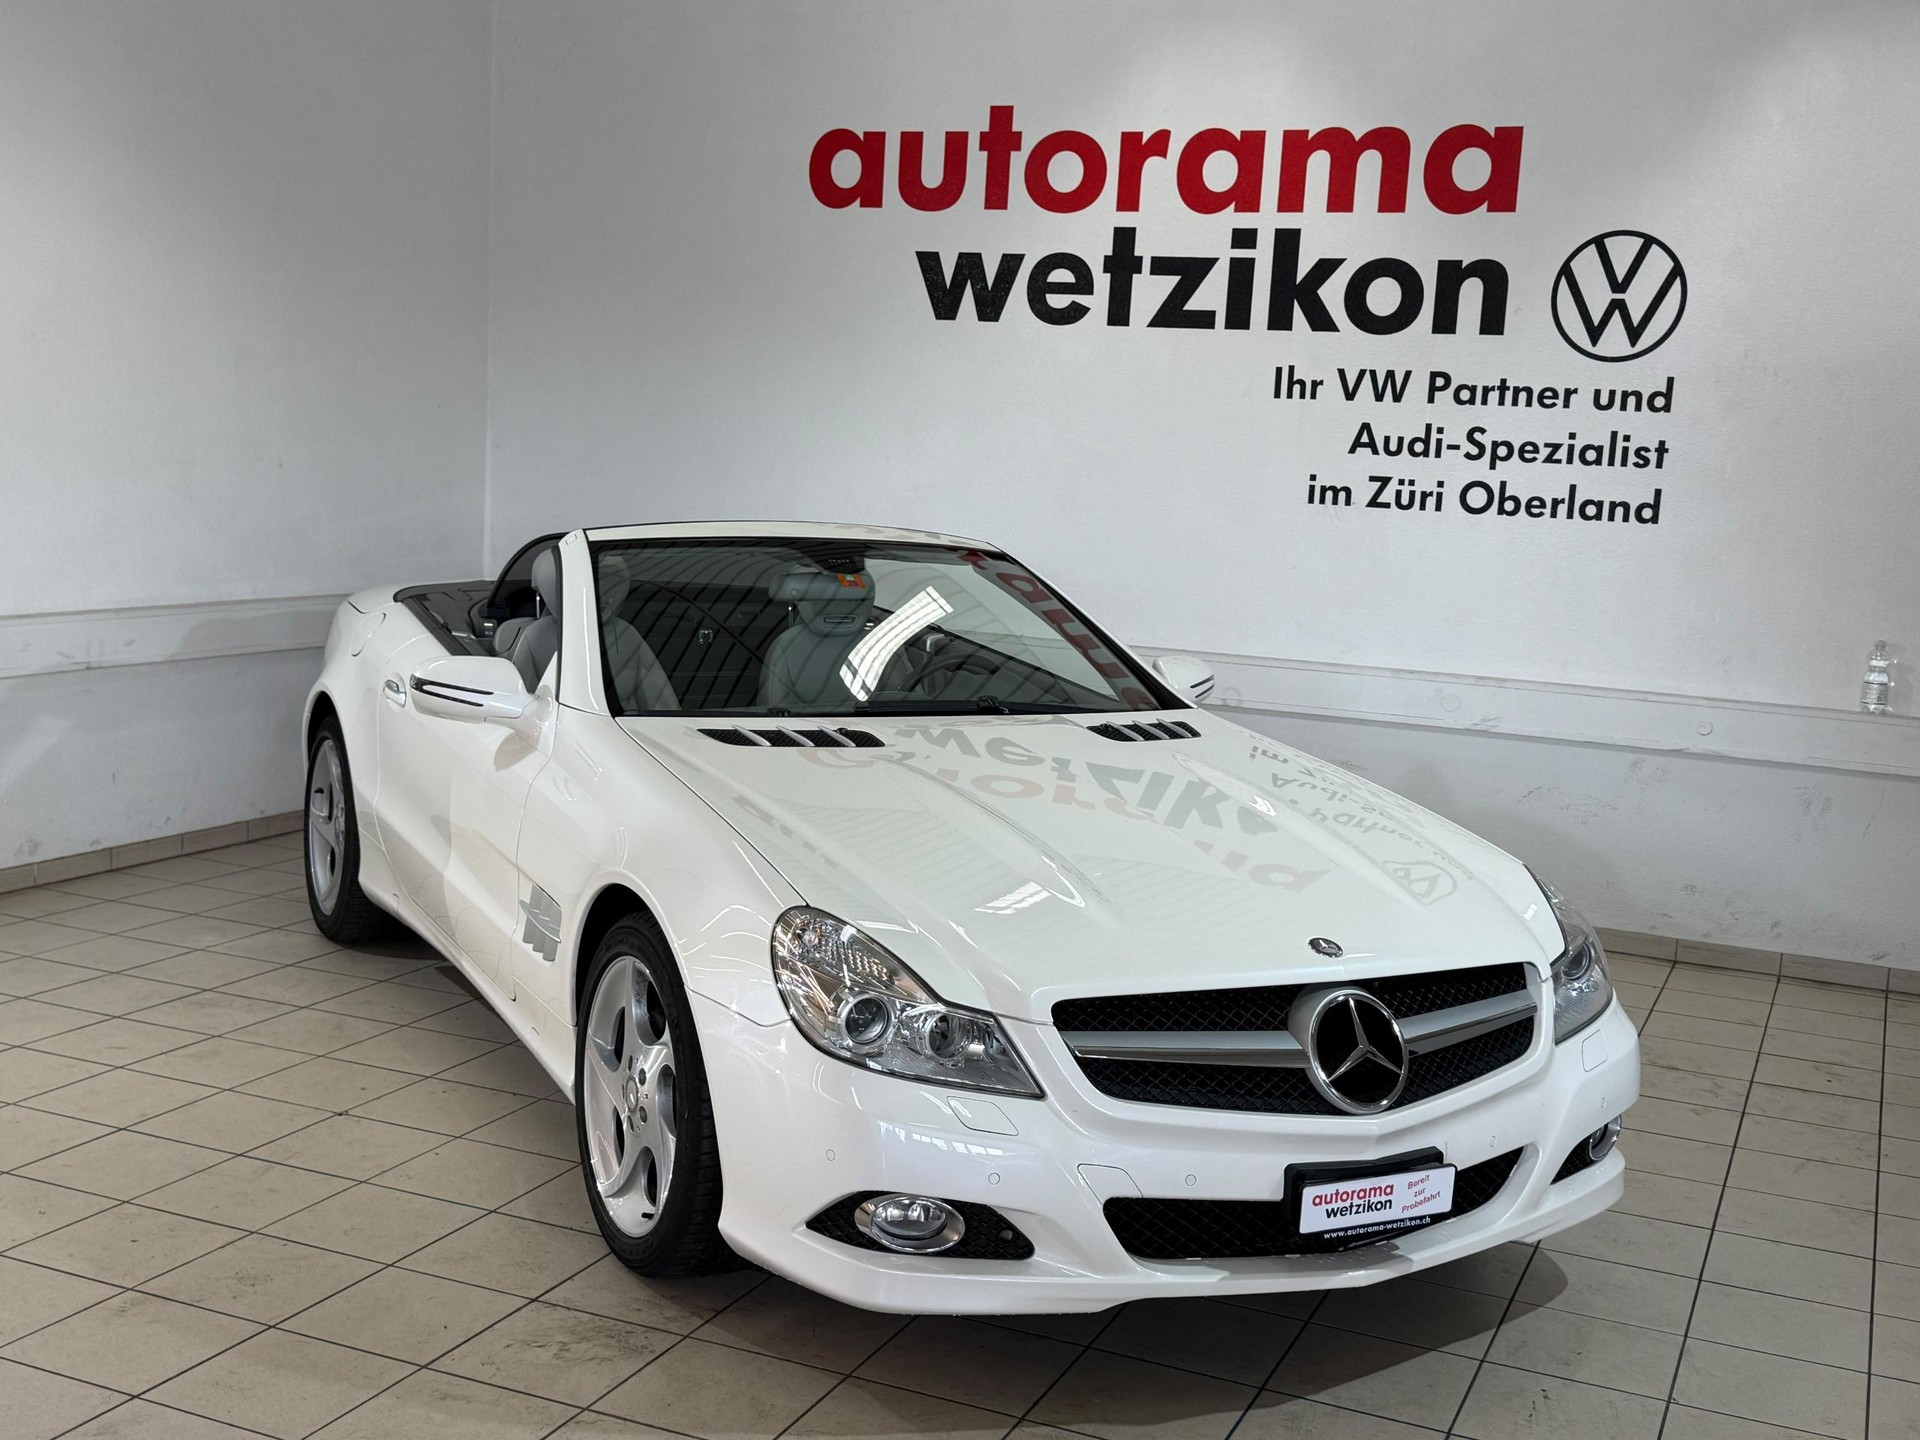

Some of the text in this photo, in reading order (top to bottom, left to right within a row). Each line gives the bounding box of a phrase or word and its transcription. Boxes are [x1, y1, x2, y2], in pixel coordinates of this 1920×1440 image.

[809, 105, 1524, 214] autorama
[914, 227, 1508, 335] wetzikon
[1273, 366, 1674, 413] Ihr VW Partner und
[1347, 422, 1669, 470] Audi-Spezialist
[1307, 474, 1663, 524] im Züri Oberland
[1407, 1174, 1430, 1190] Bereit
[1413, 1187, 1426, 1198] zur
[1312, 1184, 1394, 1207] autorama
[1401, 1190, 1441, 1214] Probefahrt
[1325, 1199, 1393, 1219] wetzikon
[1323, 1216, 1431, 1239] www.autorama-wetzikon.ch
